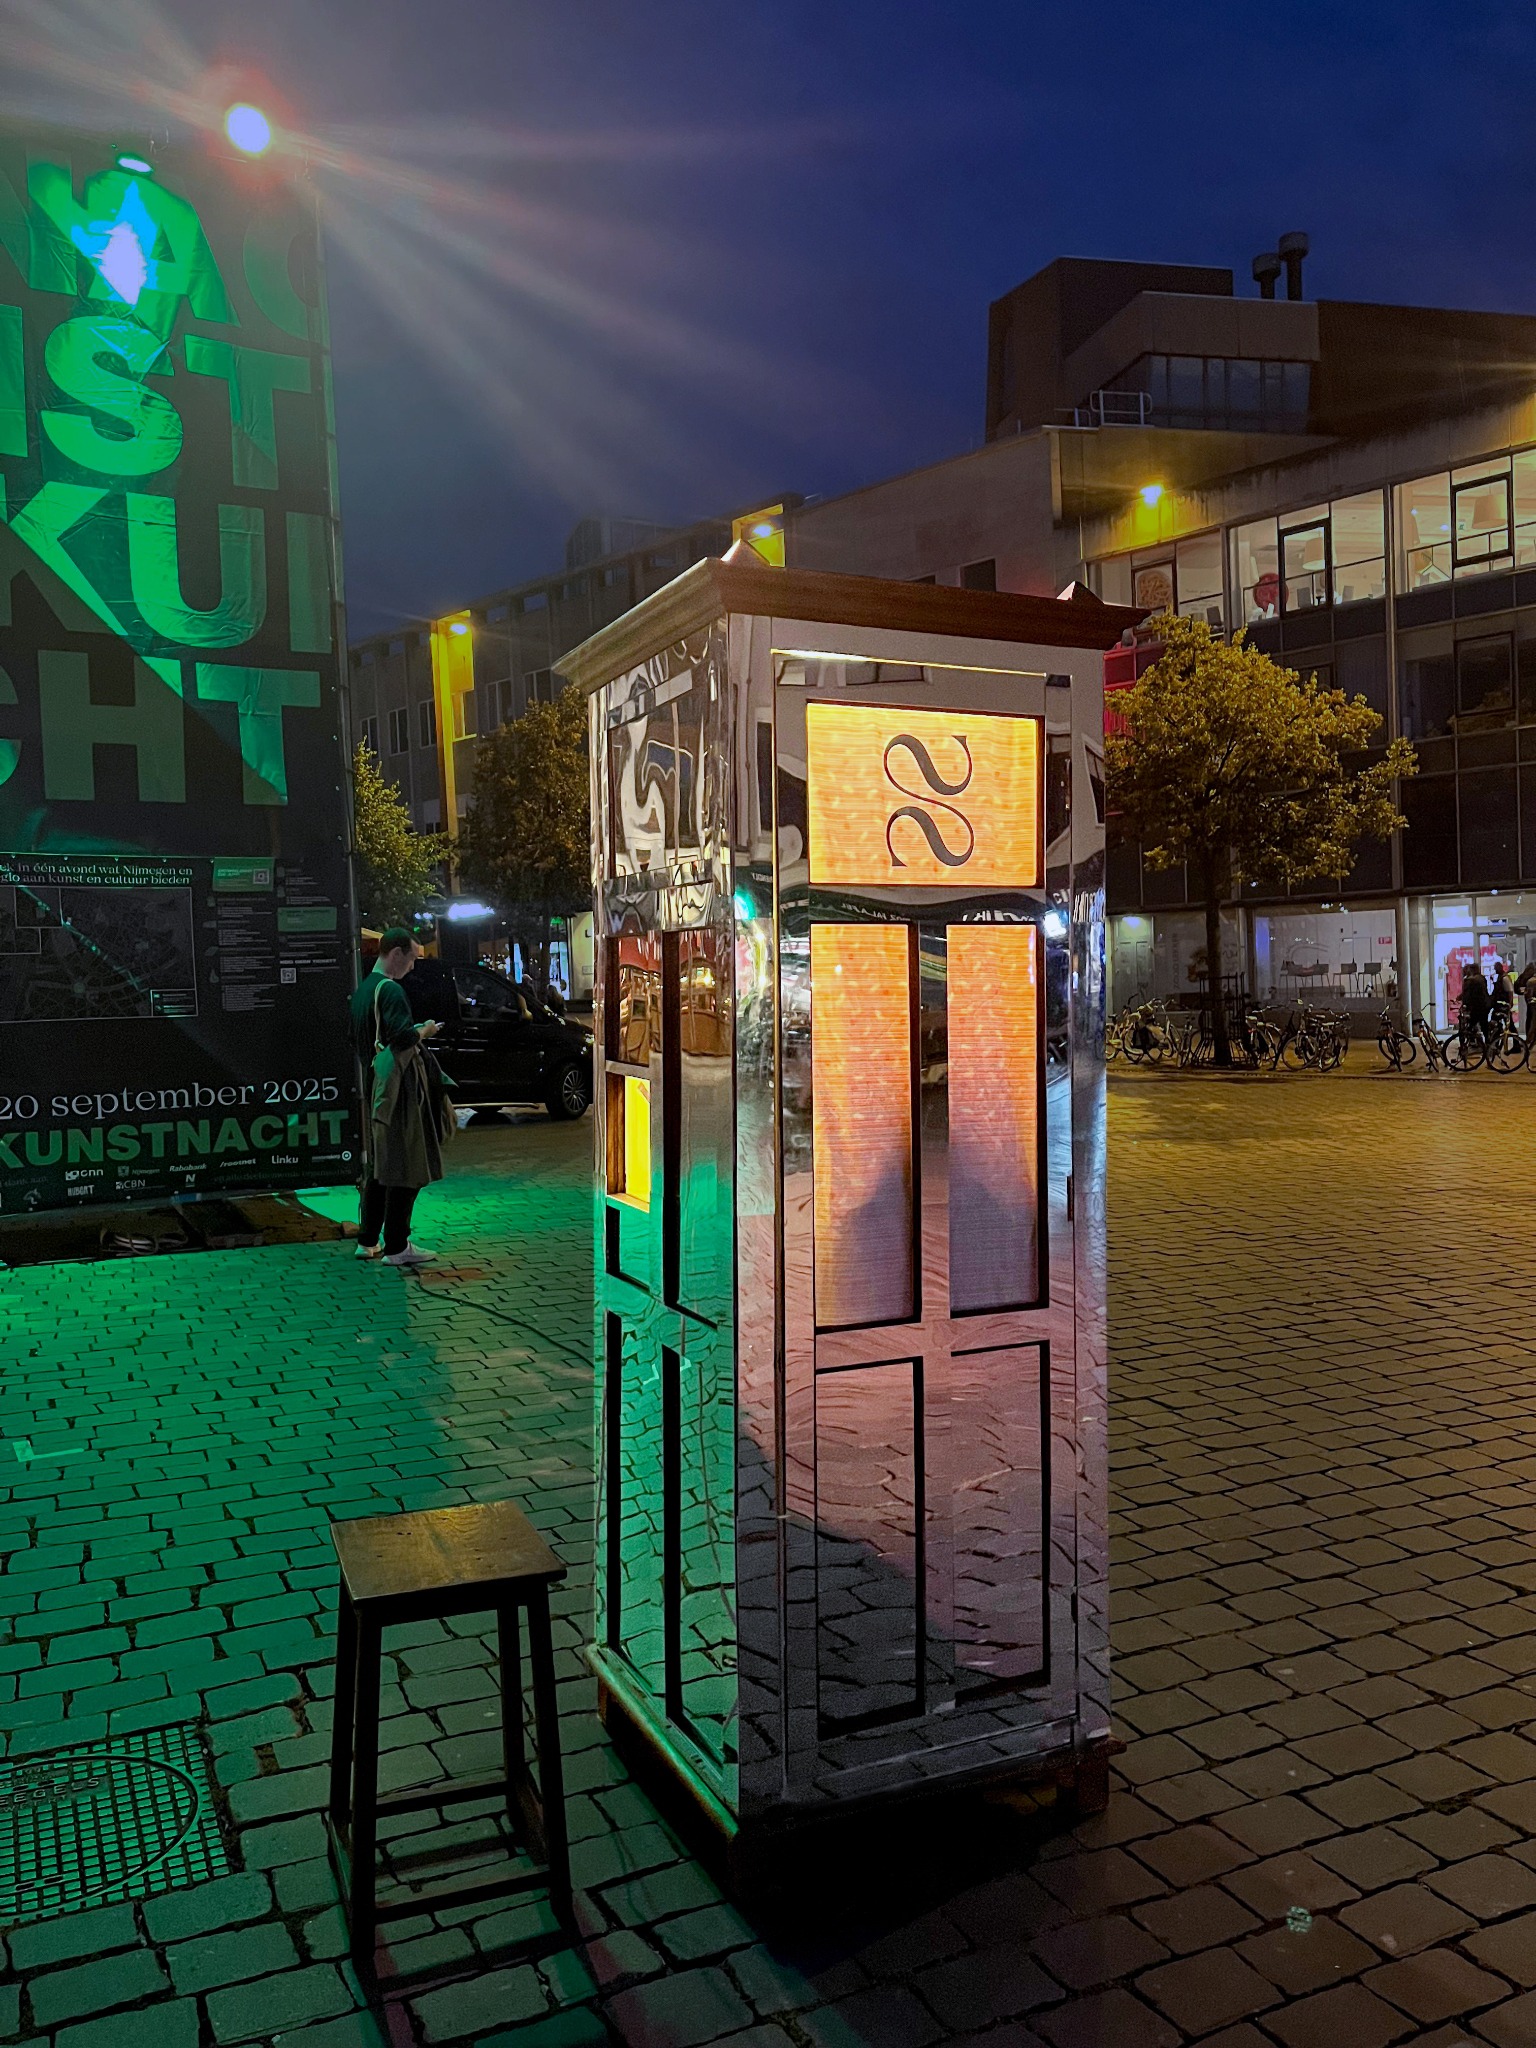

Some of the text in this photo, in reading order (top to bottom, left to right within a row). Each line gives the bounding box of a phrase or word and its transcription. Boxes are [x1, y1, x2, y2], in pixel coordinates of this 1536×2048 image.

[59, 864, 96, 874] avond
[99, 865, 120, 875] wat
[123, 865, 176, 877] Nijmegen
[178, 867, 193, 876] en
[23, 874, 45, 883] aan
[48, 873, 83, 883] kunst
[86, 875, 100, 884] en
[104, 874, 148, 884] cultuur
[151, 873, 190, 885] bieden
[0, 1077, 339, 1120] 20 september 2025
[169, 1162, 207, 1172] Rabobank
